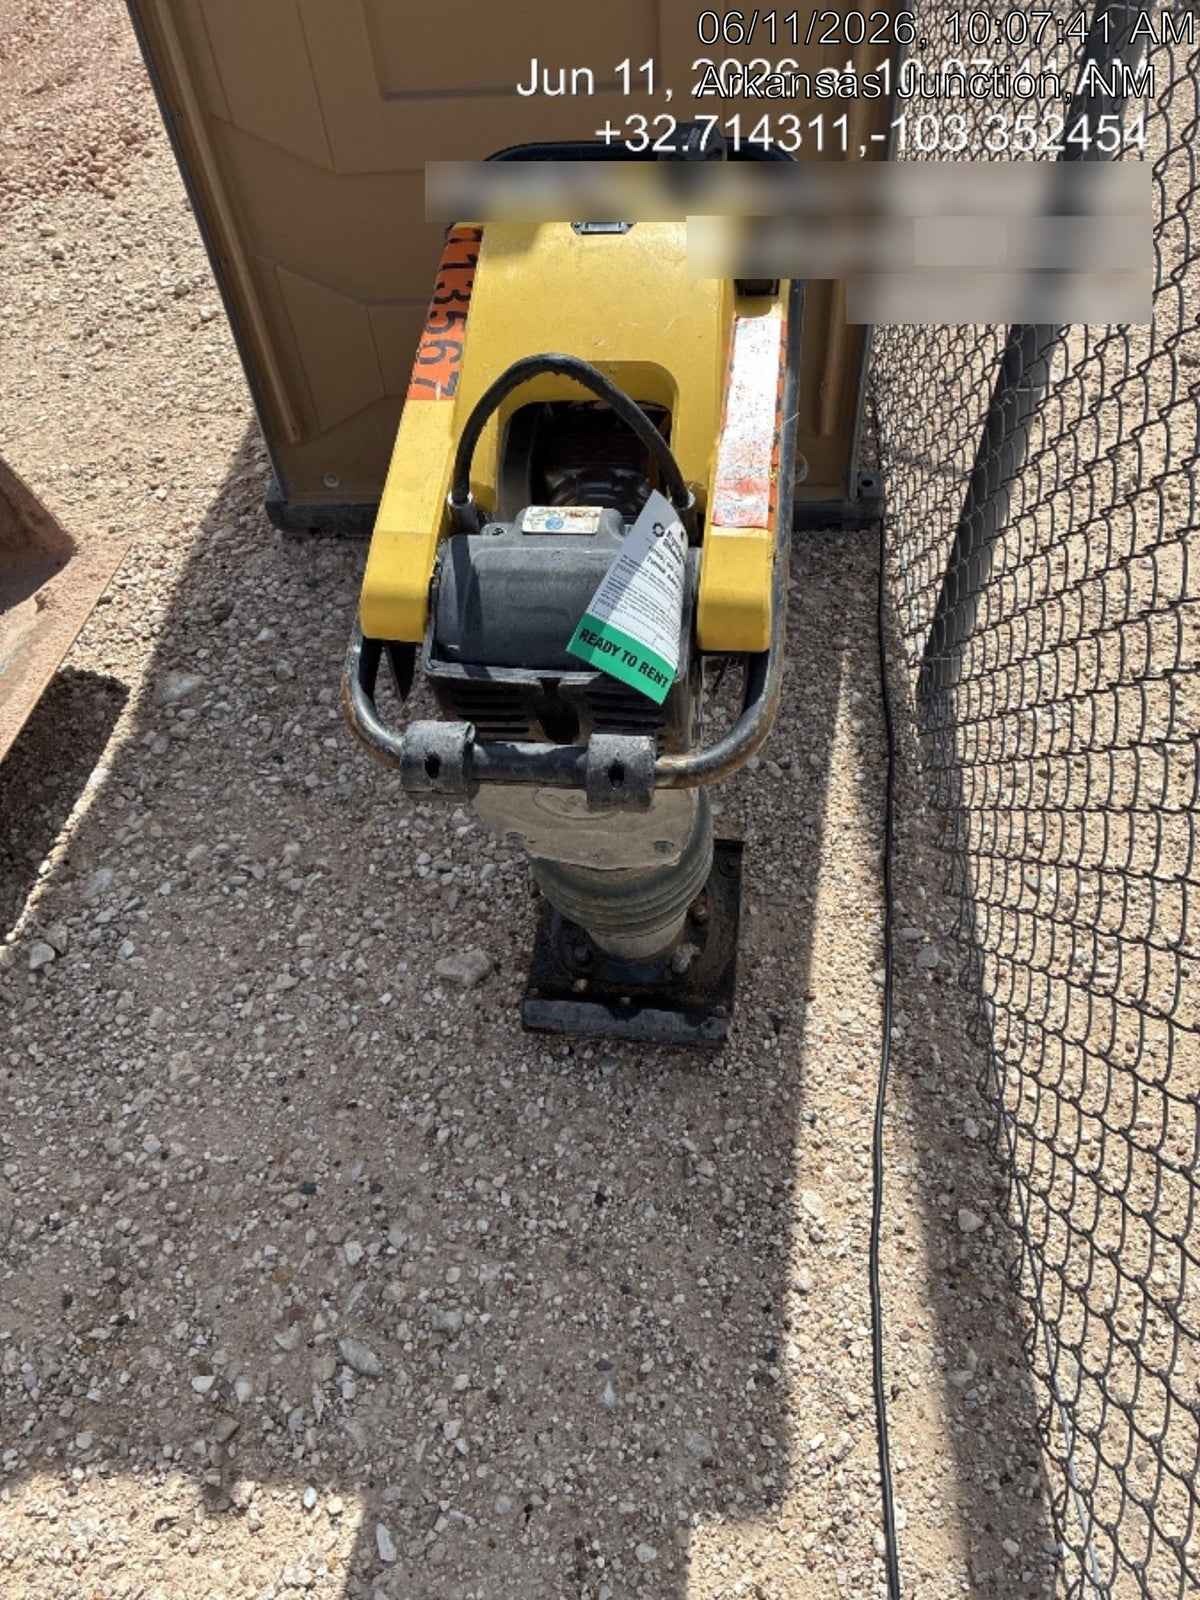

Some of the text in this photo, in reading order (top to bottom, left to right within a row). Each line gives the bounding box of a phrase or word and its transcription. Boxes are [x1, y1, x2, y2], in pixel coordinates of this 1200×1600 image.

[579, 628, 670, 689] READY TO RENT
